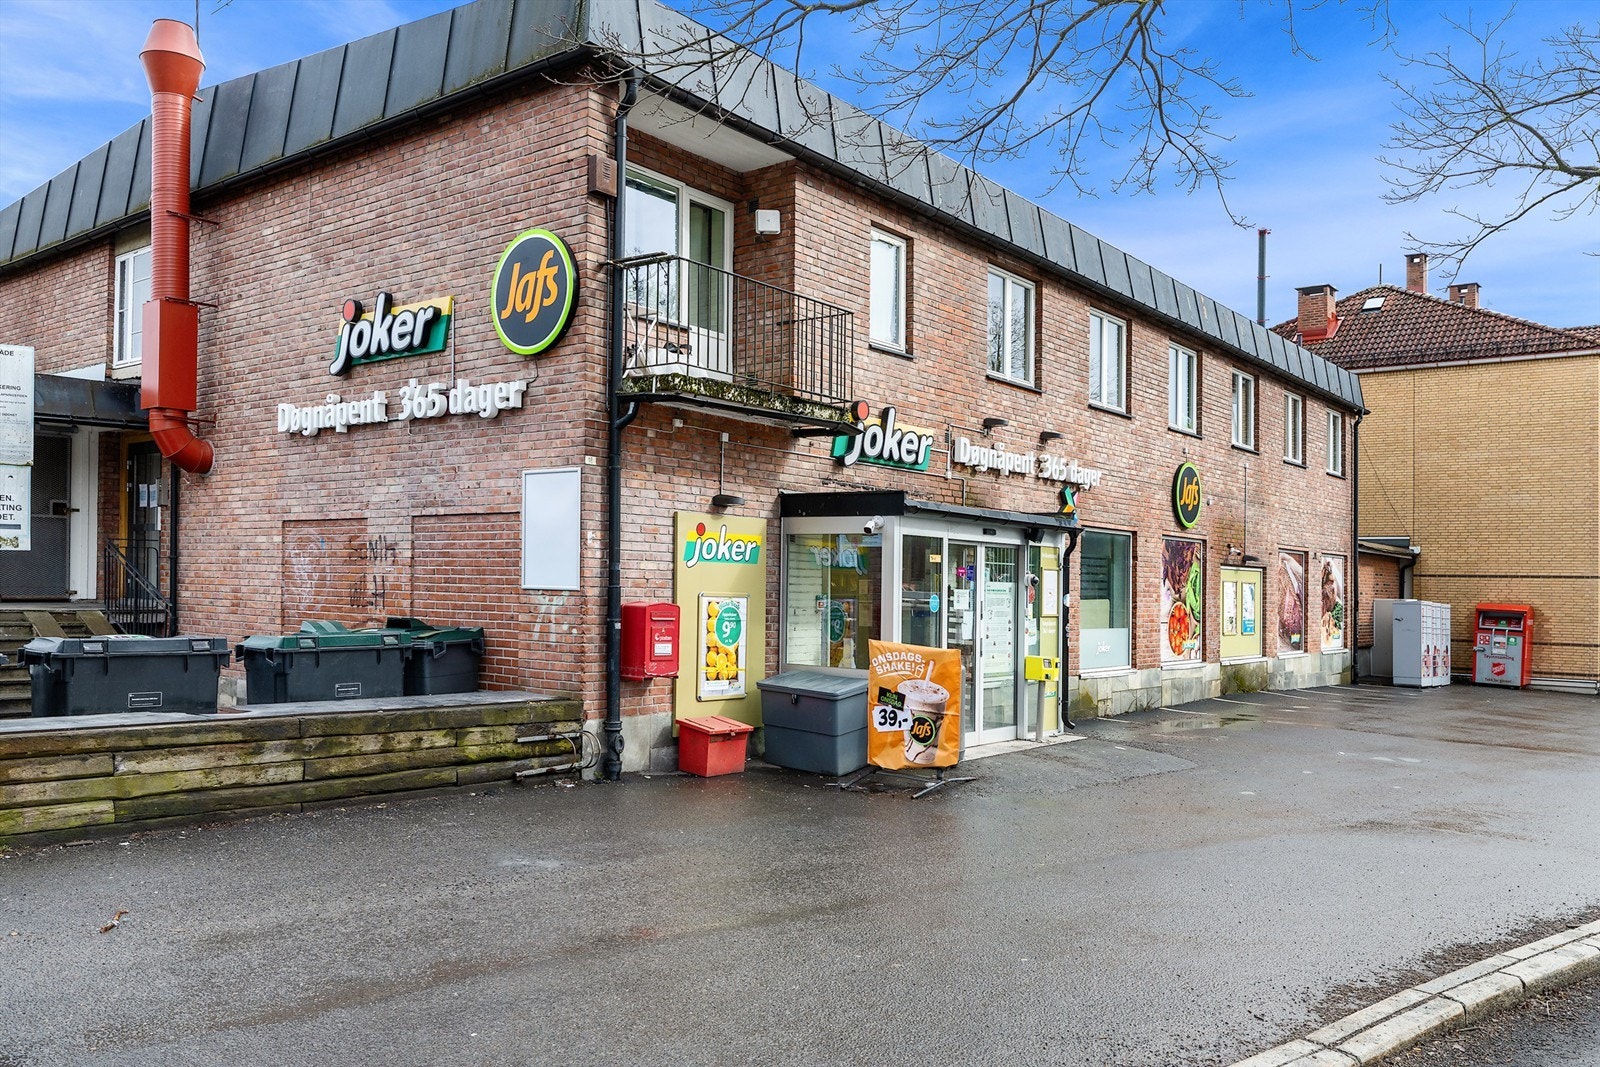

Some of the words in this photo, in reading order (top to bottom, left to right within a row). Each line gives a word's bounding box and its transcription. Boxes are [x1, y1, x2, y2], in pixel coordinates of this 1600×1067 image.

[501, 250, 559, 323] Jafs
[329, 291, 441, 376] joker
[278, 394, 388, 437] Døgnåpent
[398, 378, 447, 420] 365
[448, 378, 527, 419] dager
[844, 400, 934, 467] joker
[954, 436, 1036, 476] Døgnåpent
[1039, 454, 1068, 484] 365
[1069, 462, 1101, 489] dager
[1180, 476, 1199, 512] Jafs
[686, 523, 758, 568] joker
[872, 652, 926, 667] ONSDAGS-
[876, 661, 915, 675] SHAKE!
[911, 721, 931, 738] Jafs
